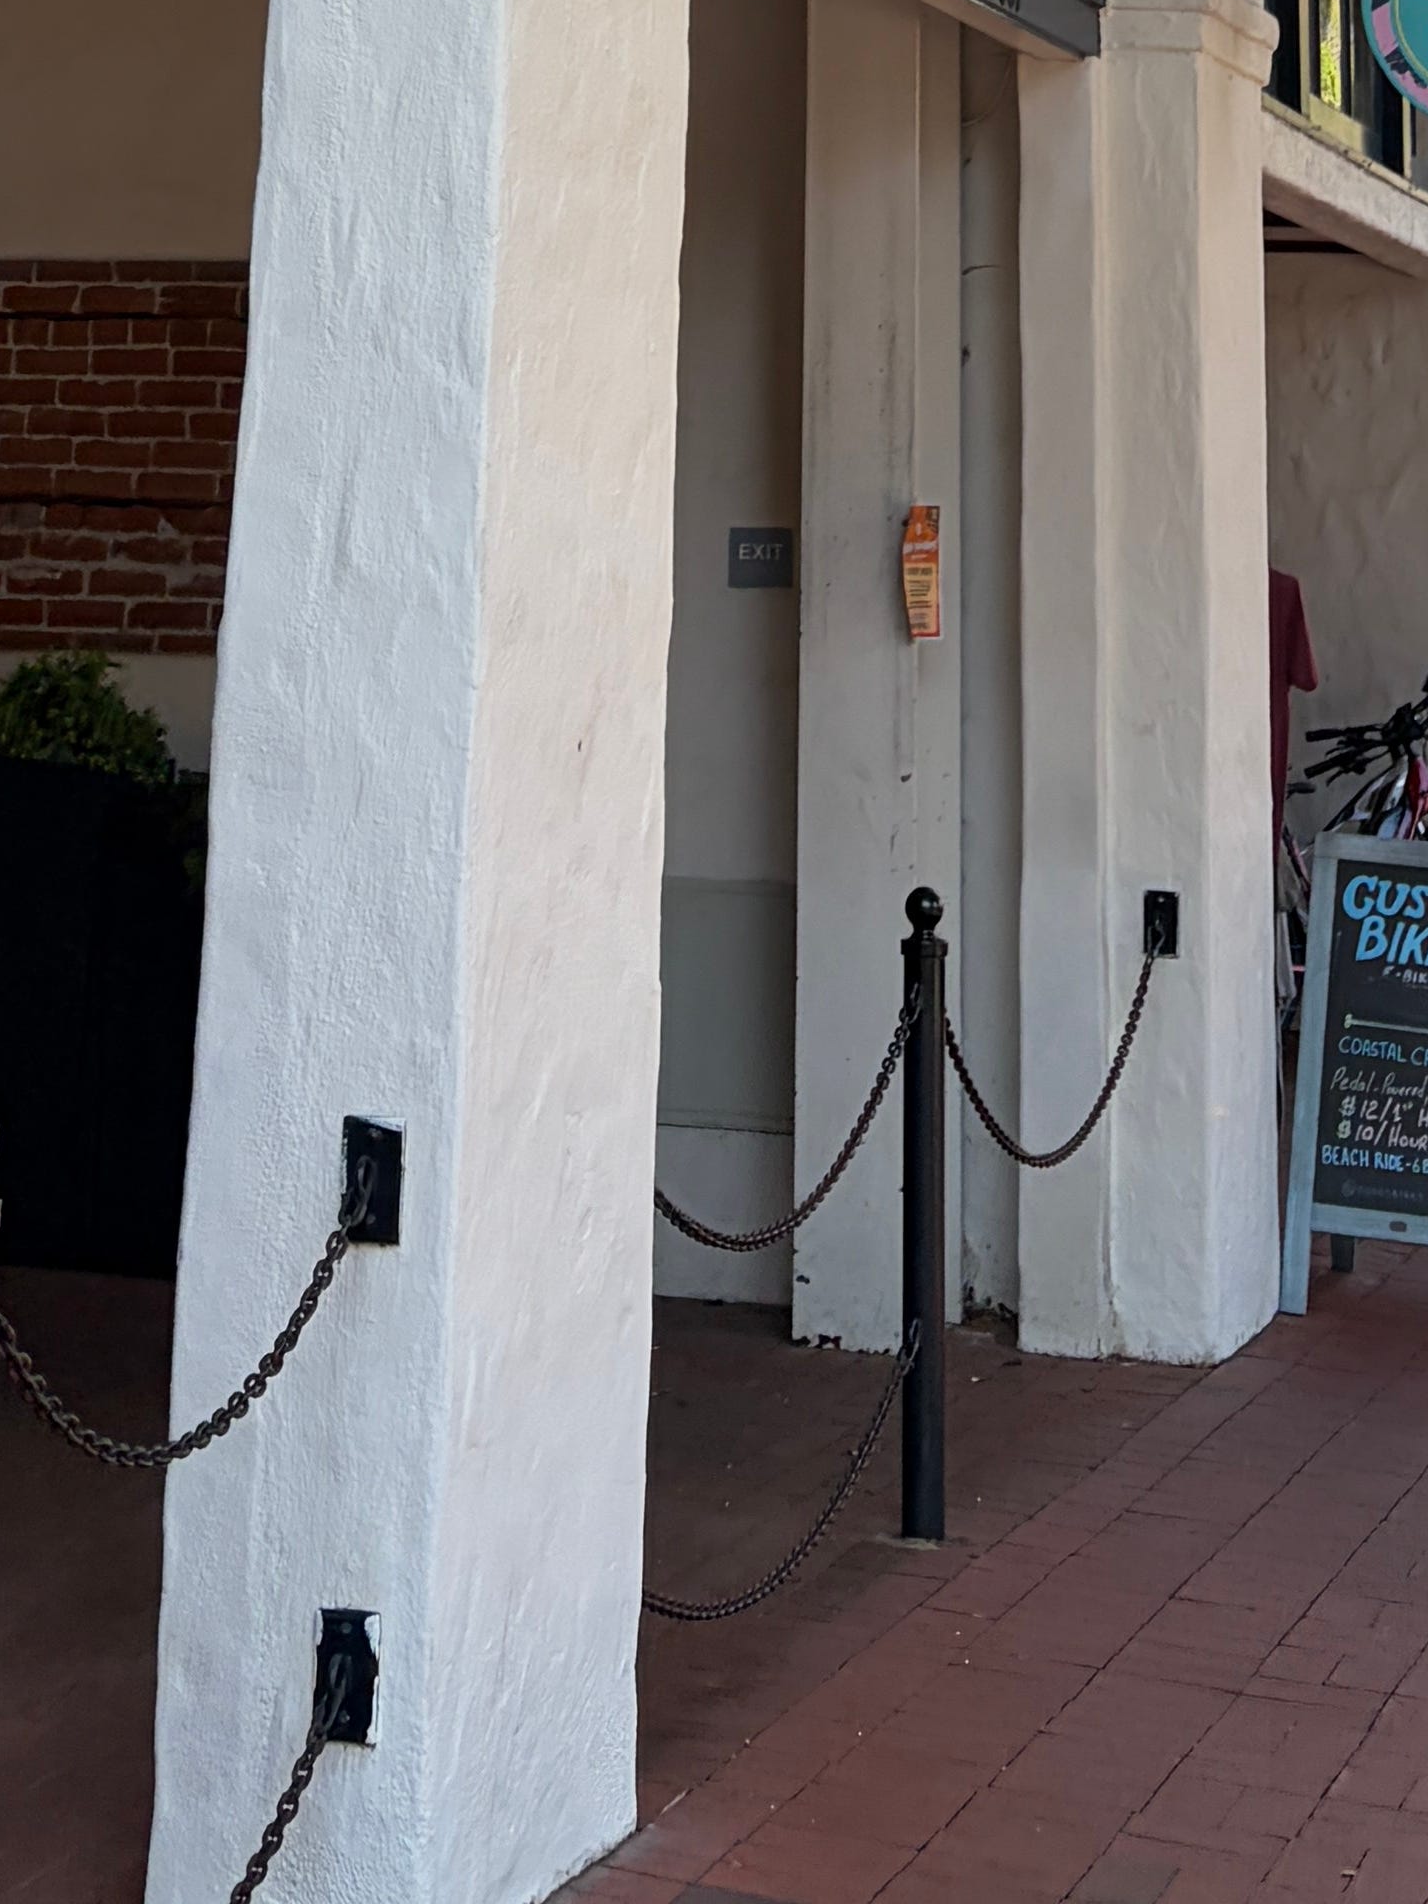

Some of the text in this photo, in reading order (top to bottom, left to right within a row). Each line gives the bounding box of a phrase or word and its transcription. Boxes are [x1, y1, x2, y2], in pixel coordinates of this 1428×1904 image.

[738, 543, 784, 561] EXIT
[1338, 1035, 1408, 1063] COASTAL
[1321, 1144, 1369, 1168] BEACH
